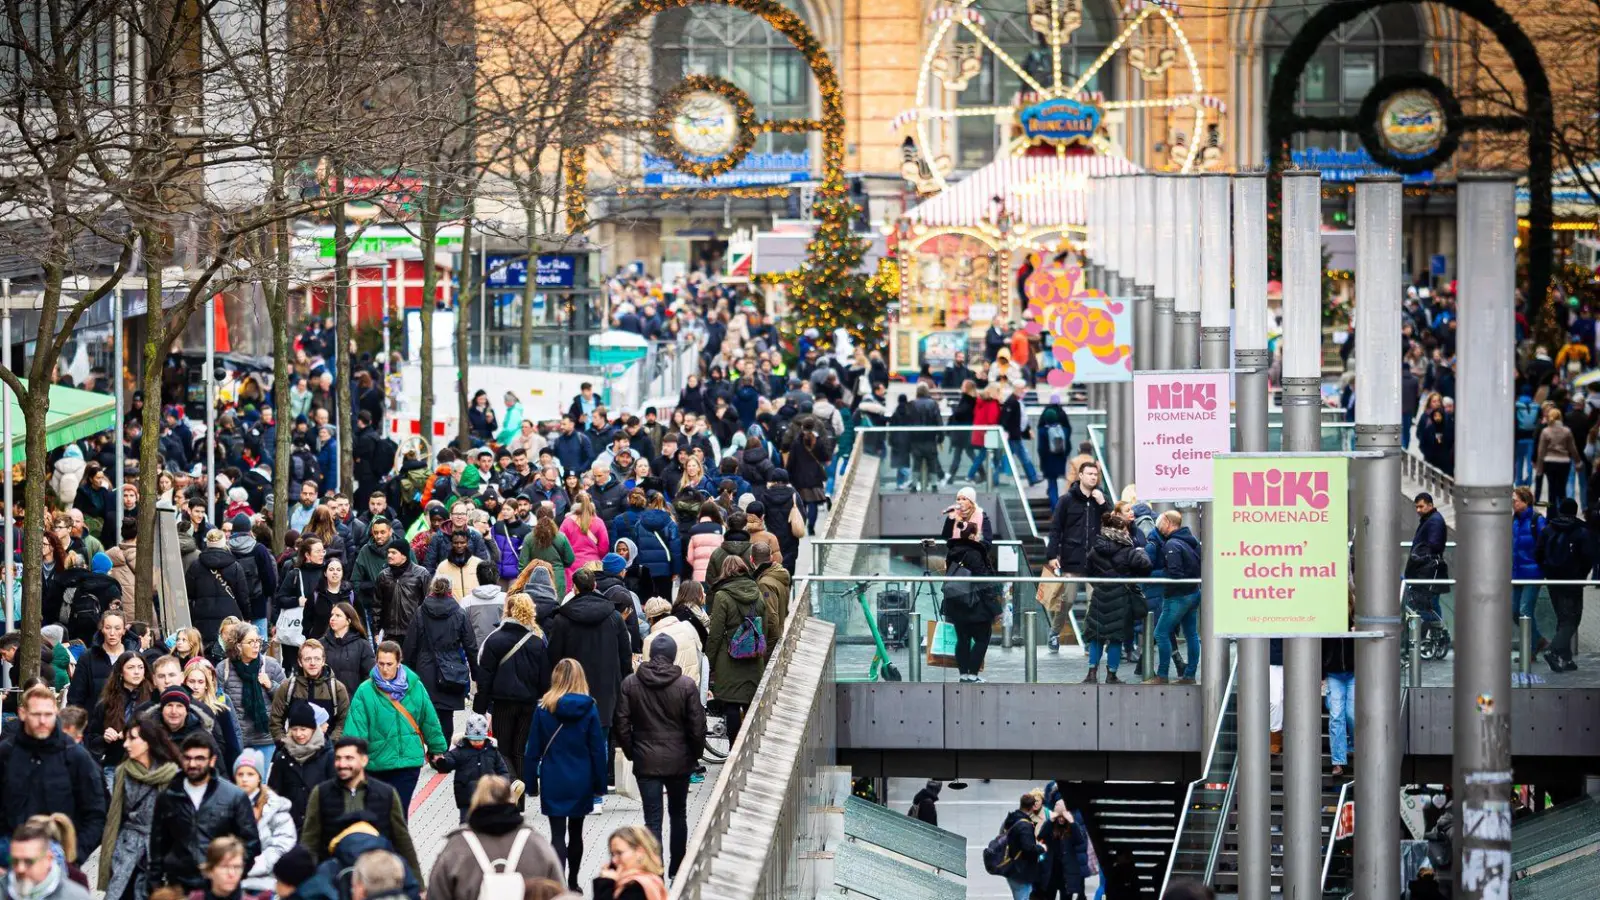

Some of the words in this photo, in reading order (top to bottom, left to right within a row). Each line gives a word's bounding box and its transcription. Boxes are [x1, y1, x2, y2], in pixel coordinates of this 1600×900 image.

[1147, 411, 1217, 421] PROMENADE
[1154, 463, 1190, 479] Style
[1232, 510, 1329, 523] PROMENADE
[1243, 562, 1293, 578] doch
[1299, 562, 1337, 578] mal
[1232, 585, 1296, 600] runter
